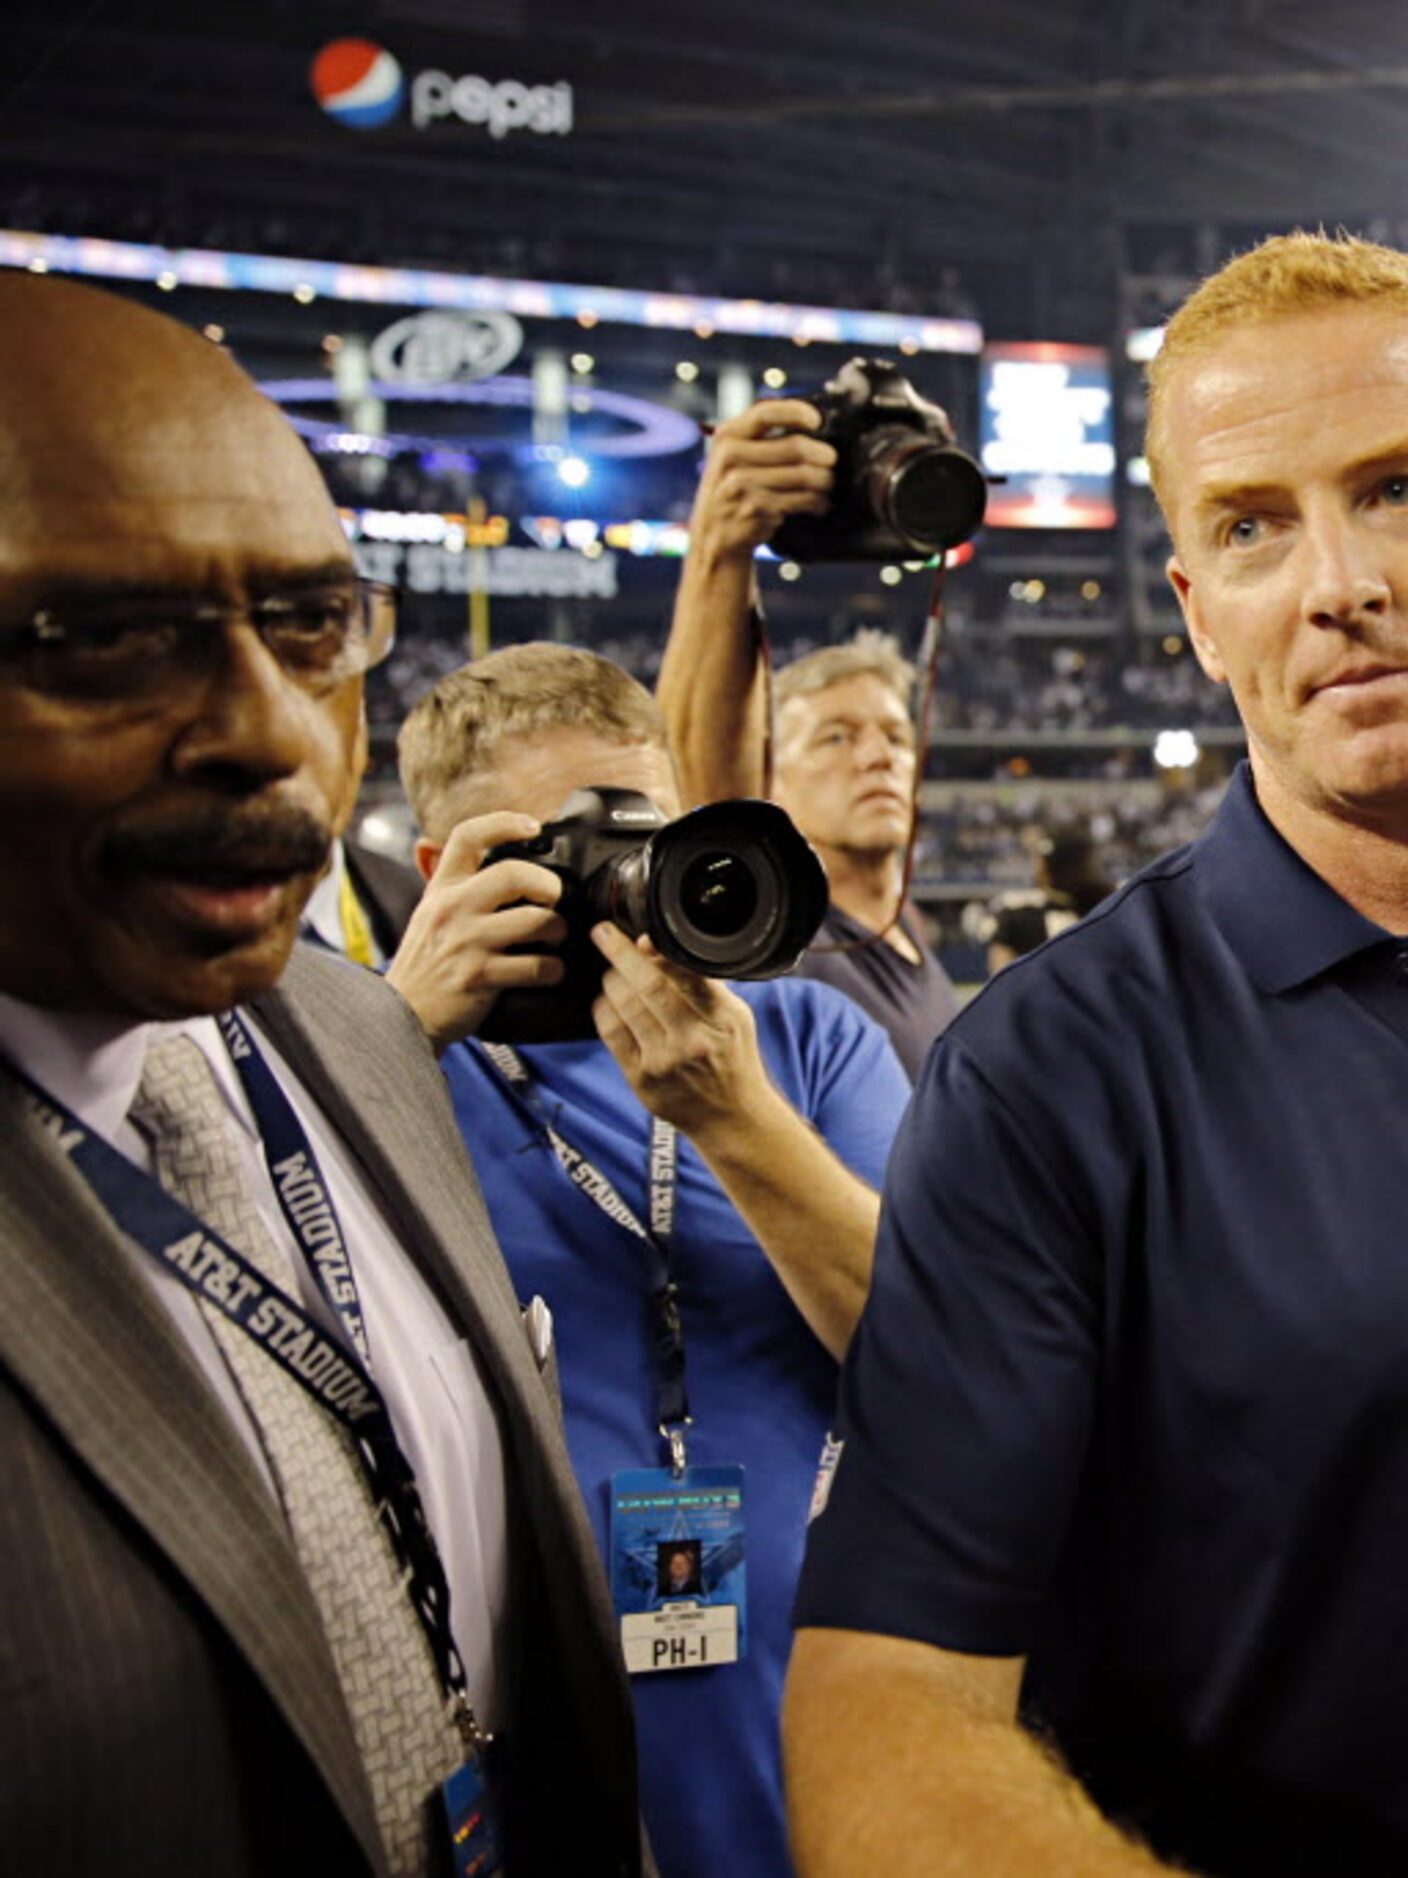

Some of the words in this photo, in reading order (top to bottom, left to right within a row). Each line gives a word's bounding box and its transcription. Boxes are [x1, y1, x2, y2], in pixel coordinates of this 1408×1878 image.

[412, 69, 573, 139] pepsi
[611, 810, 656, 821] Canon
[273, 1151, 356, 1304] STADIUM
[164, 1231, 262, 1313] AT&T
[248, 1296, 380, 1420] STADIUM
